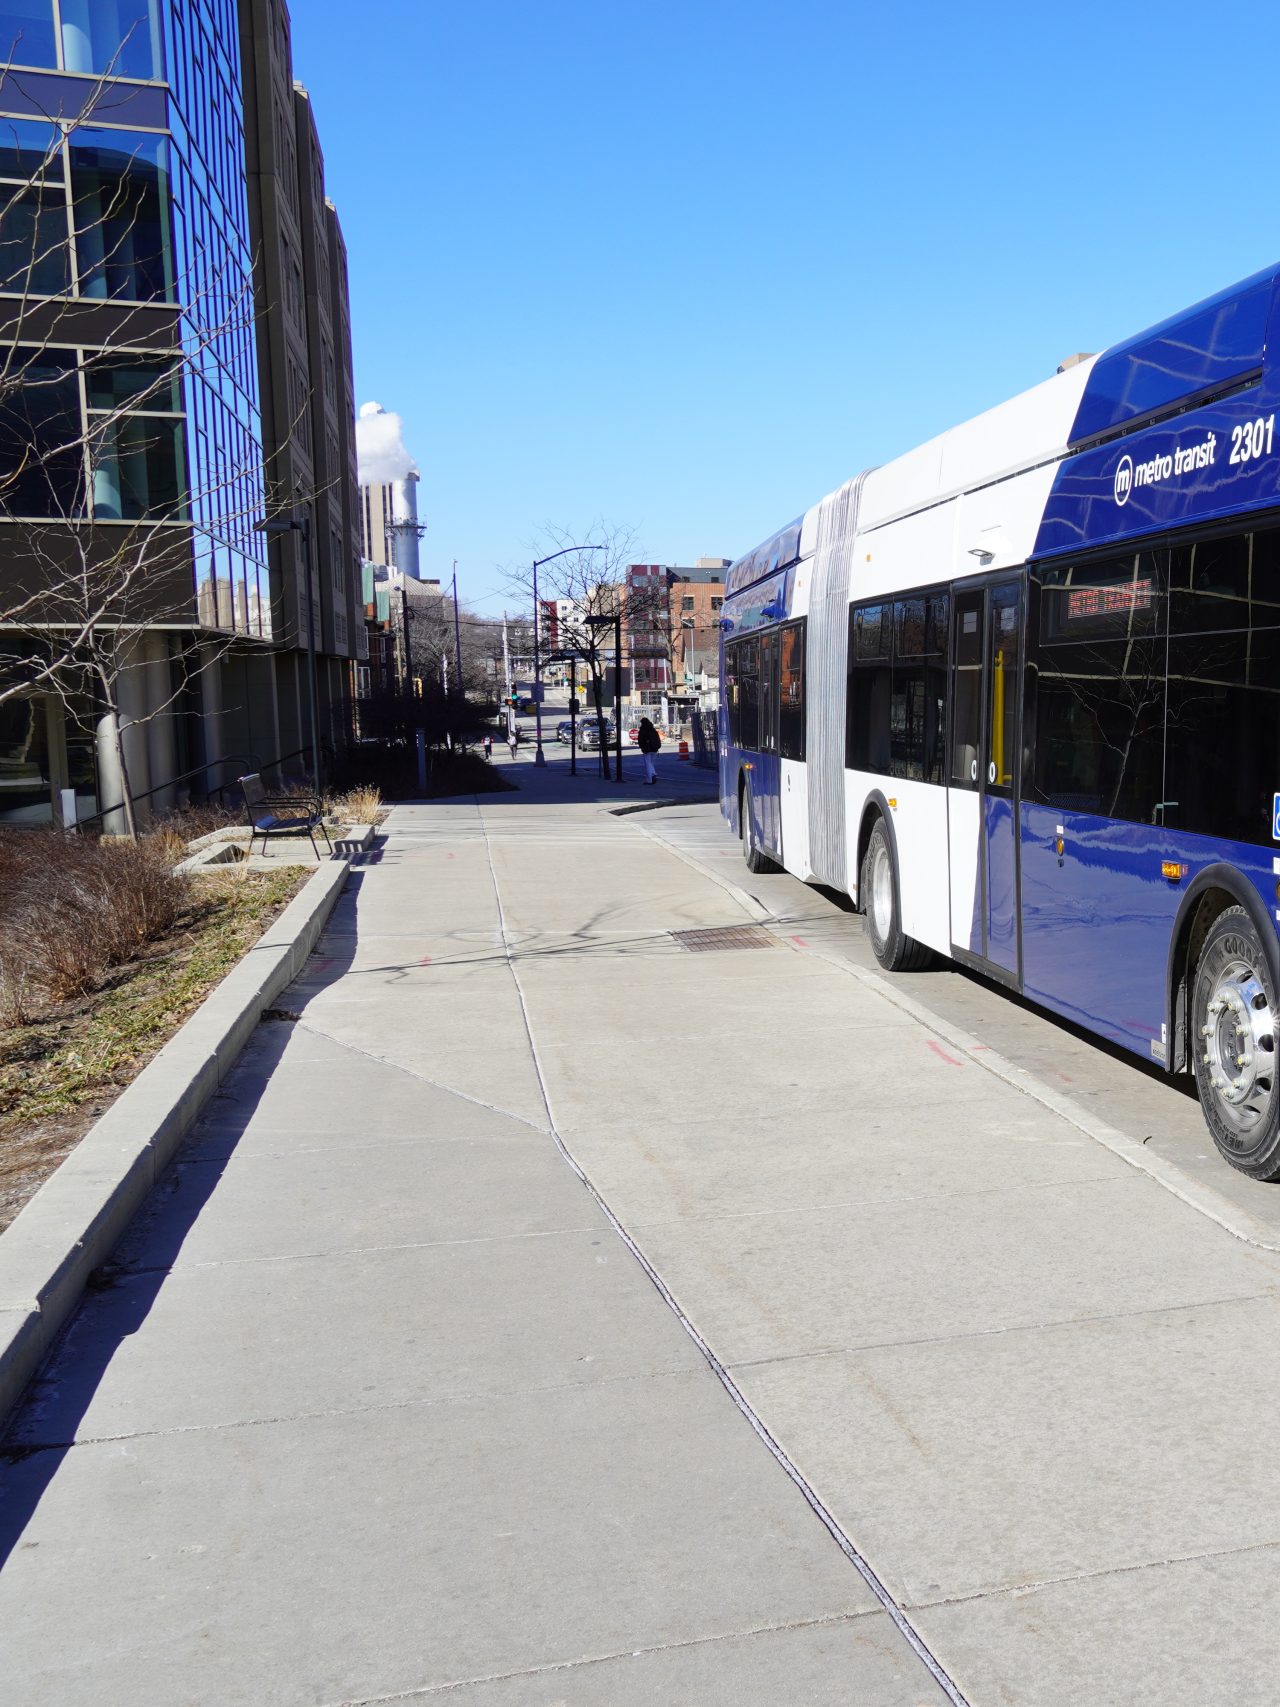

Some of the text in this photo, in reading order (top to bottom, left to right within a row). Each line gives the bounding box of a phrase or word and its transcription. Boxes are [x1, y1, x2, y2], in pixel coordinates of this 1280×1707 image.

[1134, 453, 1172, 488] metro
[1174, 432, 1217, 476] transit
[1229, 414, 1275, 465] 2301
